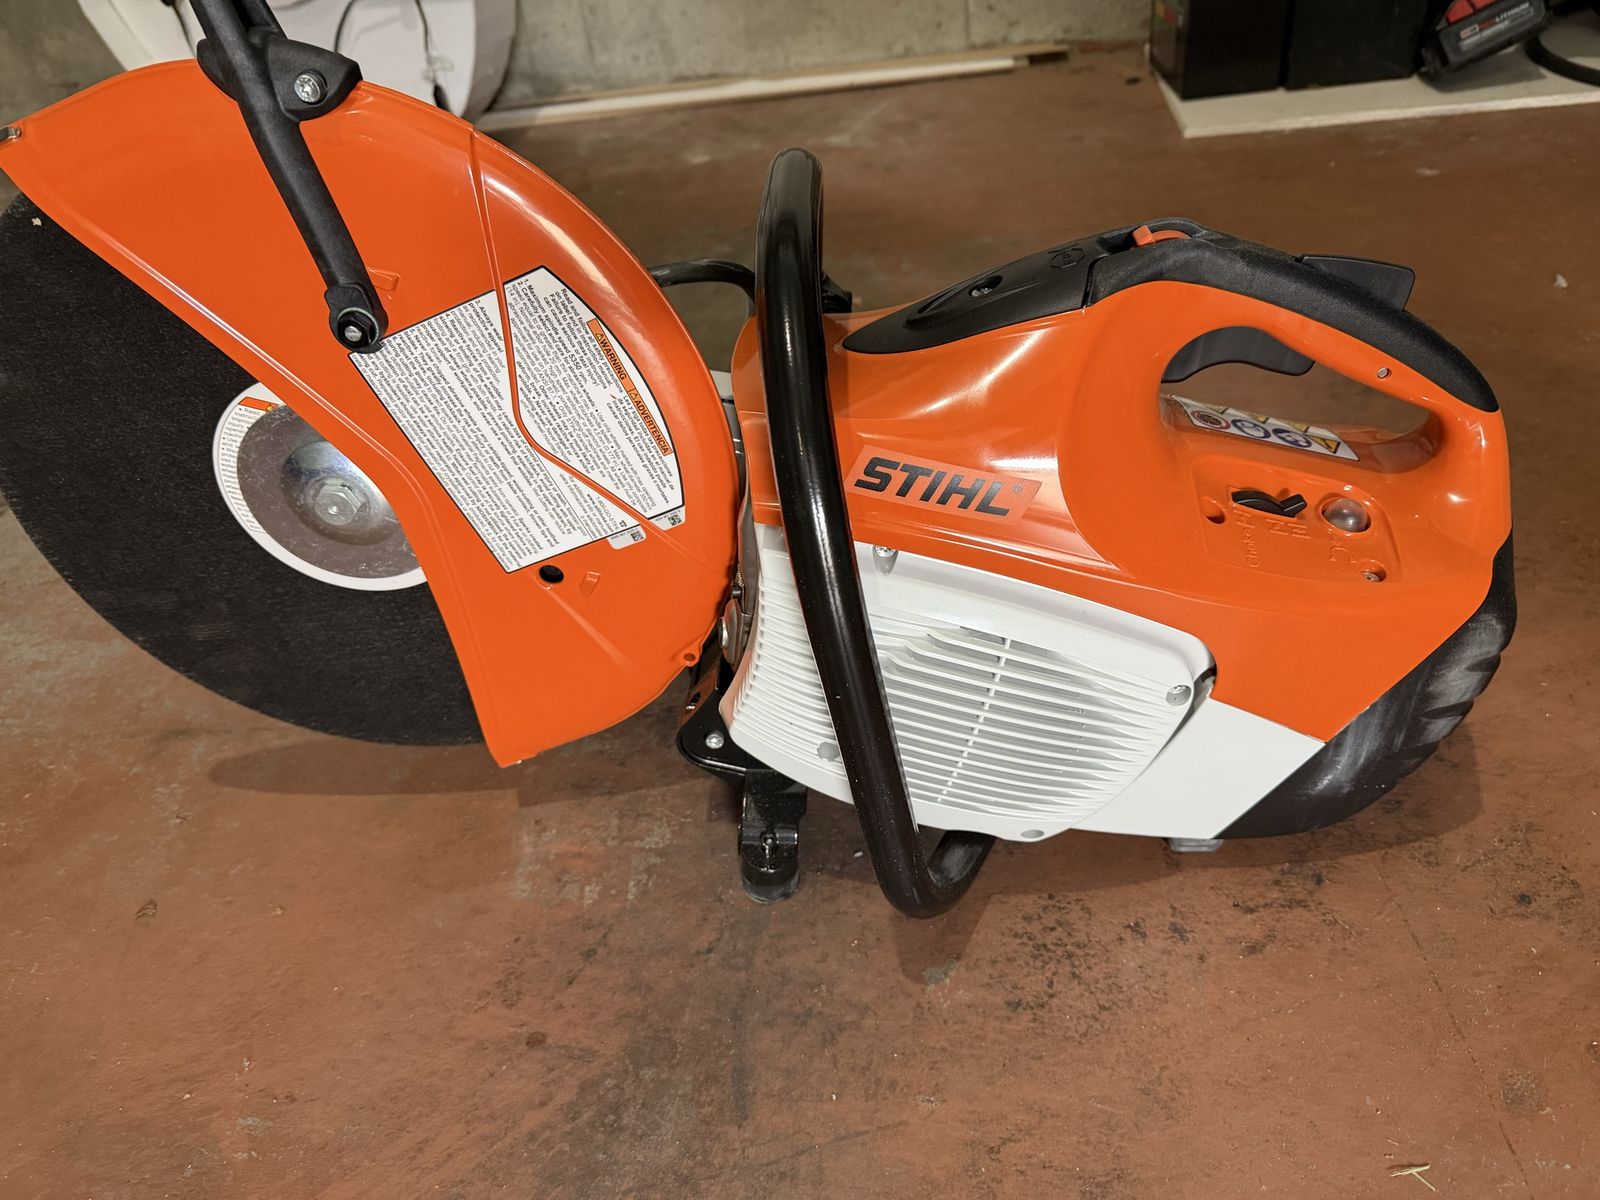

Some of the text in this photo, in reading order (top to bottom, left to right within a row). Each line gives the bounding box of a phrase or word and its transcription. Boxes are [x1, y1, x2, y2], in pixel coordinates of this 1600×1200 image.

[449, 319, 467, 344] Reactive
[465, 344, 479, 362] forces
[477, 362, 488, 376] from
[489, 381, 504, 401] sudden
[468, 302, 504, 353] protective apparel
[478, 306, 494, 327] Always
[493, 328, 503, 341] wear
[521, 287, 539, 314] Carefully
[537, 314, 551, 332] select
[548, 332, 558, 344] and
[555, 344, 565, 356] care
[562, 356, 570, 365] for
[568, 366, 584, 388] abrasive
[582, 388, 595, 407] wheels:
[527, 284, 546, 314] Maximum
[544, 314, 559, 335] spindle
[557, 336, 571, 354] speed
[568, 354, 582, 370] 5350
[578, 371, 588, 384] rpm.
[543, 297, 552, 308] can
[550, 309, 563, 326] cause
[561, 327, 576, 348] serious
[578, 355, 589, 369] fatal
[586, 368, 600, 387] injury!
[549, 293, 563, 315] Failure
[566, 322, 578, 340] follow
[576, 340, 588, 356] these
[585, 356, 607, 389] instructions
[555, 291, 562, 300] on
[560, 300, 572, 315] label
[569, 316, 579, 327] and
[580, 334, 600, 365] instruction
[598, 363, 613, 386] manual.
[561, 288, 626, 393] Read and follow all safety precautions
[600, 339, 627, 380] WARNING
[420, 323, 436, 342] proper
[434, 343, 451, 365] support
[453, 372, 473, 401] workpiece,
[473, 401, 483, 412] and
[480, 412, 492, 426] never
[490, 427, 499, 436] use
[500, 441, 513, 456] wheel
[510, 456, 519, 466] that
[517, 466, 533, 487] wobbles.
[427, 321, 446, 347] quadrant
[449, 353, 462, 370] wheel
[460, 370, 473, 387] where
[470, 387, 488, 411] possible,
[486, 411, 503, 431] prevent
[500, 431, 518, 455] pinching,
[516, 455, 535, 479] especially
[542, 493, 554, 506] upper
[551, 507, 568, 528] quadrant,
[439, 316, 456, 338] slowing
[458, 345, 474, 367] binding
[477, 373, 485, 383] the
[483, 383, 497, 399] wheel
[494, 400, 503, 411] may
[502, 412, 514, 427] cause
[512, 427, 522, 439] loss
[524, 445, 539, 463] control
[536, 463, 545, 473] and
[542, 472, 554, 487] injury
[556, 493, 567, 507] death.
[515, 360, 591, 474] deform, break, increase reactive forces and/or
[518, 374, 532, 395] wobble.
[535, 400, 547, 416] Never
[545, 417, 553, 426] use
[551, 426, 569, 450] damaged
[539, 385, 551, 400] Other
[549, 401, 564, 419] wheels
[560, 420, 570, 431] may
[572, 438, 583, 451] more
[581, 451, 591, 465] likely
[612, 400, 635, 436] instrucciones.
[637, 442, 645, 452] uso
[643, 452, 658, 474] indebido
[655, 473, 667, 489] puede
[622, 405, 640, 431] seguridad
[637, 431, 653, 454] incluidas
[658, 466, 672, 484] manual
[623, 395, 631, 406] Lea
[632, 410, 640, 422] siga
[638, 422, 649, 437] todas
[651, 445, 673, 477] precauciones
[634, 400, 669, 454] ADVERTENCIA
[497, 413, 503, 421] To
[501, 421, 515, 439] reduce
[513, 439, 521, 449] risk
[524, 455, 540, 478] kickback,
[539, 478, 551, 492] avoid
[548, 492, 561, 508] cutting
[560, 508, 568, 518] with
[566, 518, 577, 531] upper
[606, 402, 619, 420] causar
[617, 420, 629, 436] daños
[626, 436, 645, 463] personales
[642, 463, 655, 480] graves
[656, 483, 669, 504] mortales.
[854, 457, 1010, 516] STIHL
